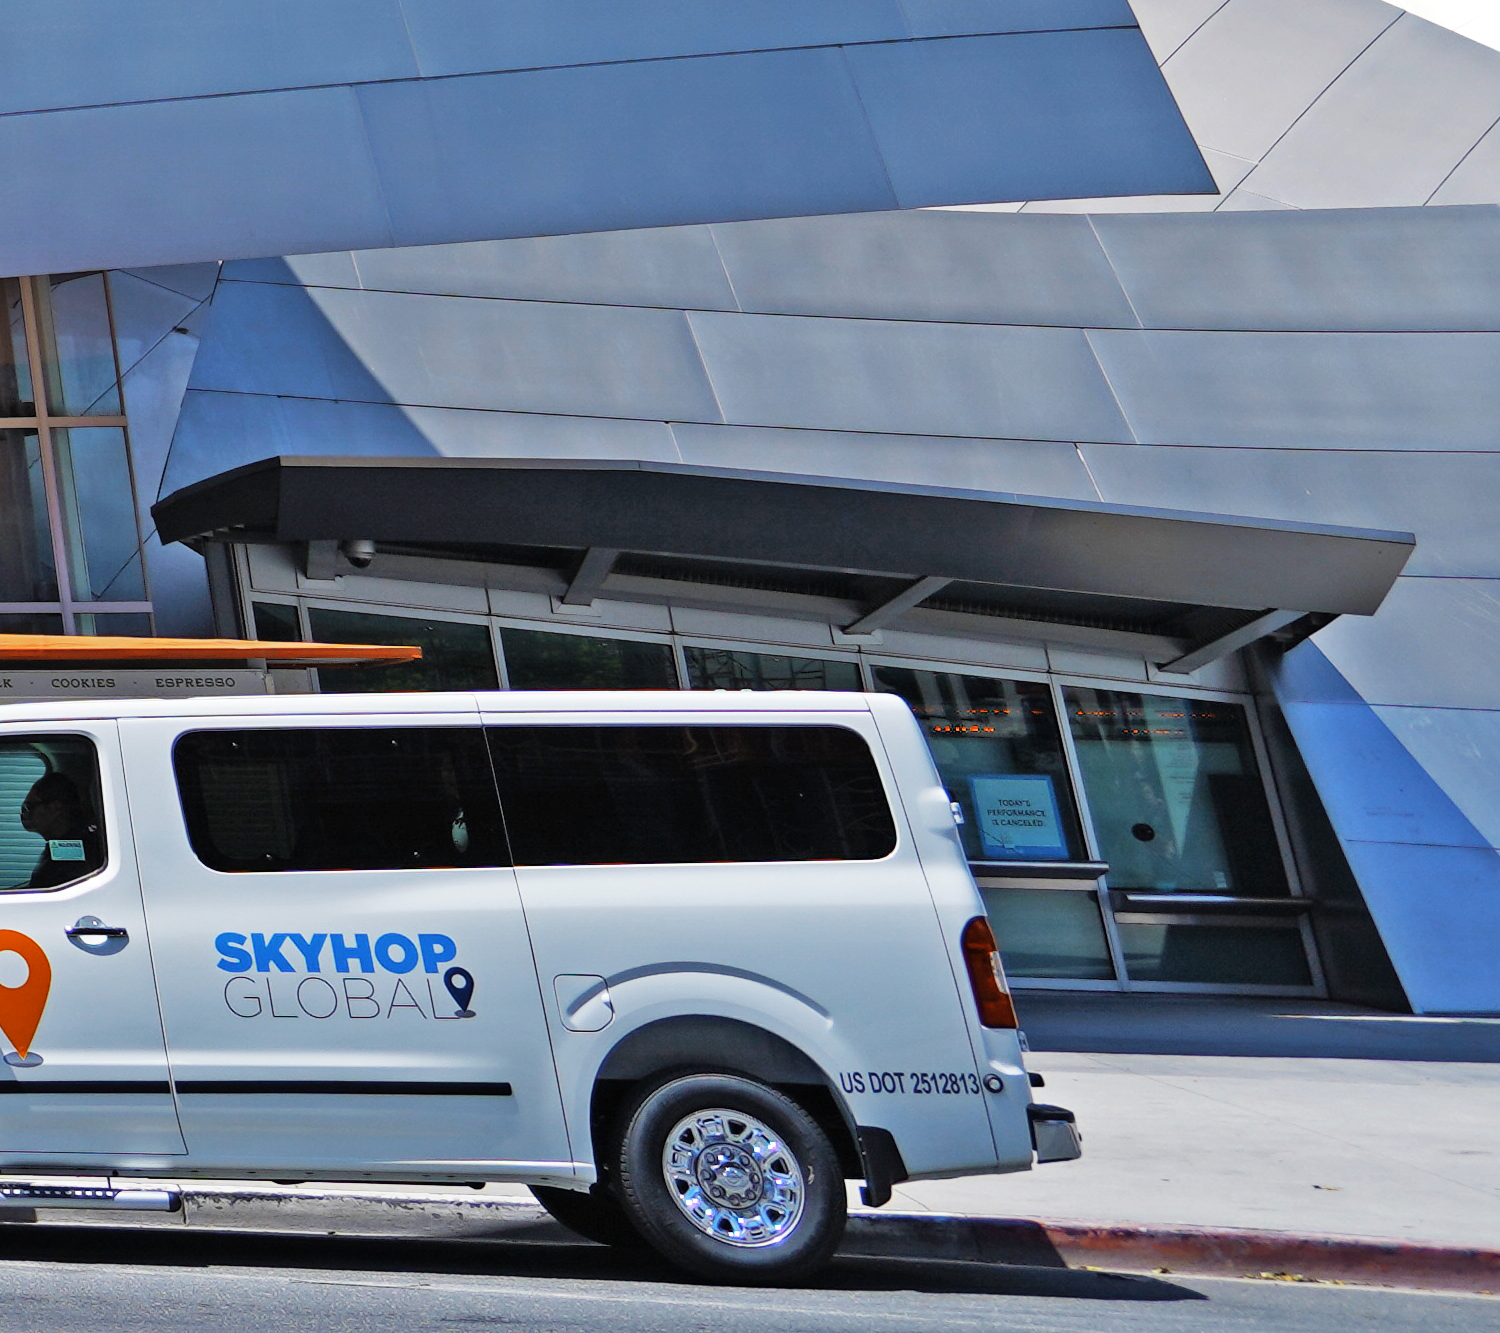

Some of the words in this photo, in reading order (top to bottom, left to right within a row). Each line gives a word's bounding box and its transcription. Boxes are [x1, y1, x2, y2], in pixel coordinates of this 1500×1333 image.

[51, 678, 116, 688] COOKIES
[155, 677, 236, 688] ESPRESSO
[214, 932, 457, 974] SKYHOP
[224, 976, 461, 1020] GLOBAL
[839, 1072, 865, 1094] US
[868, 1072, 905, 1094] DOT
[910, 1072, 980, 1094] 2512813
